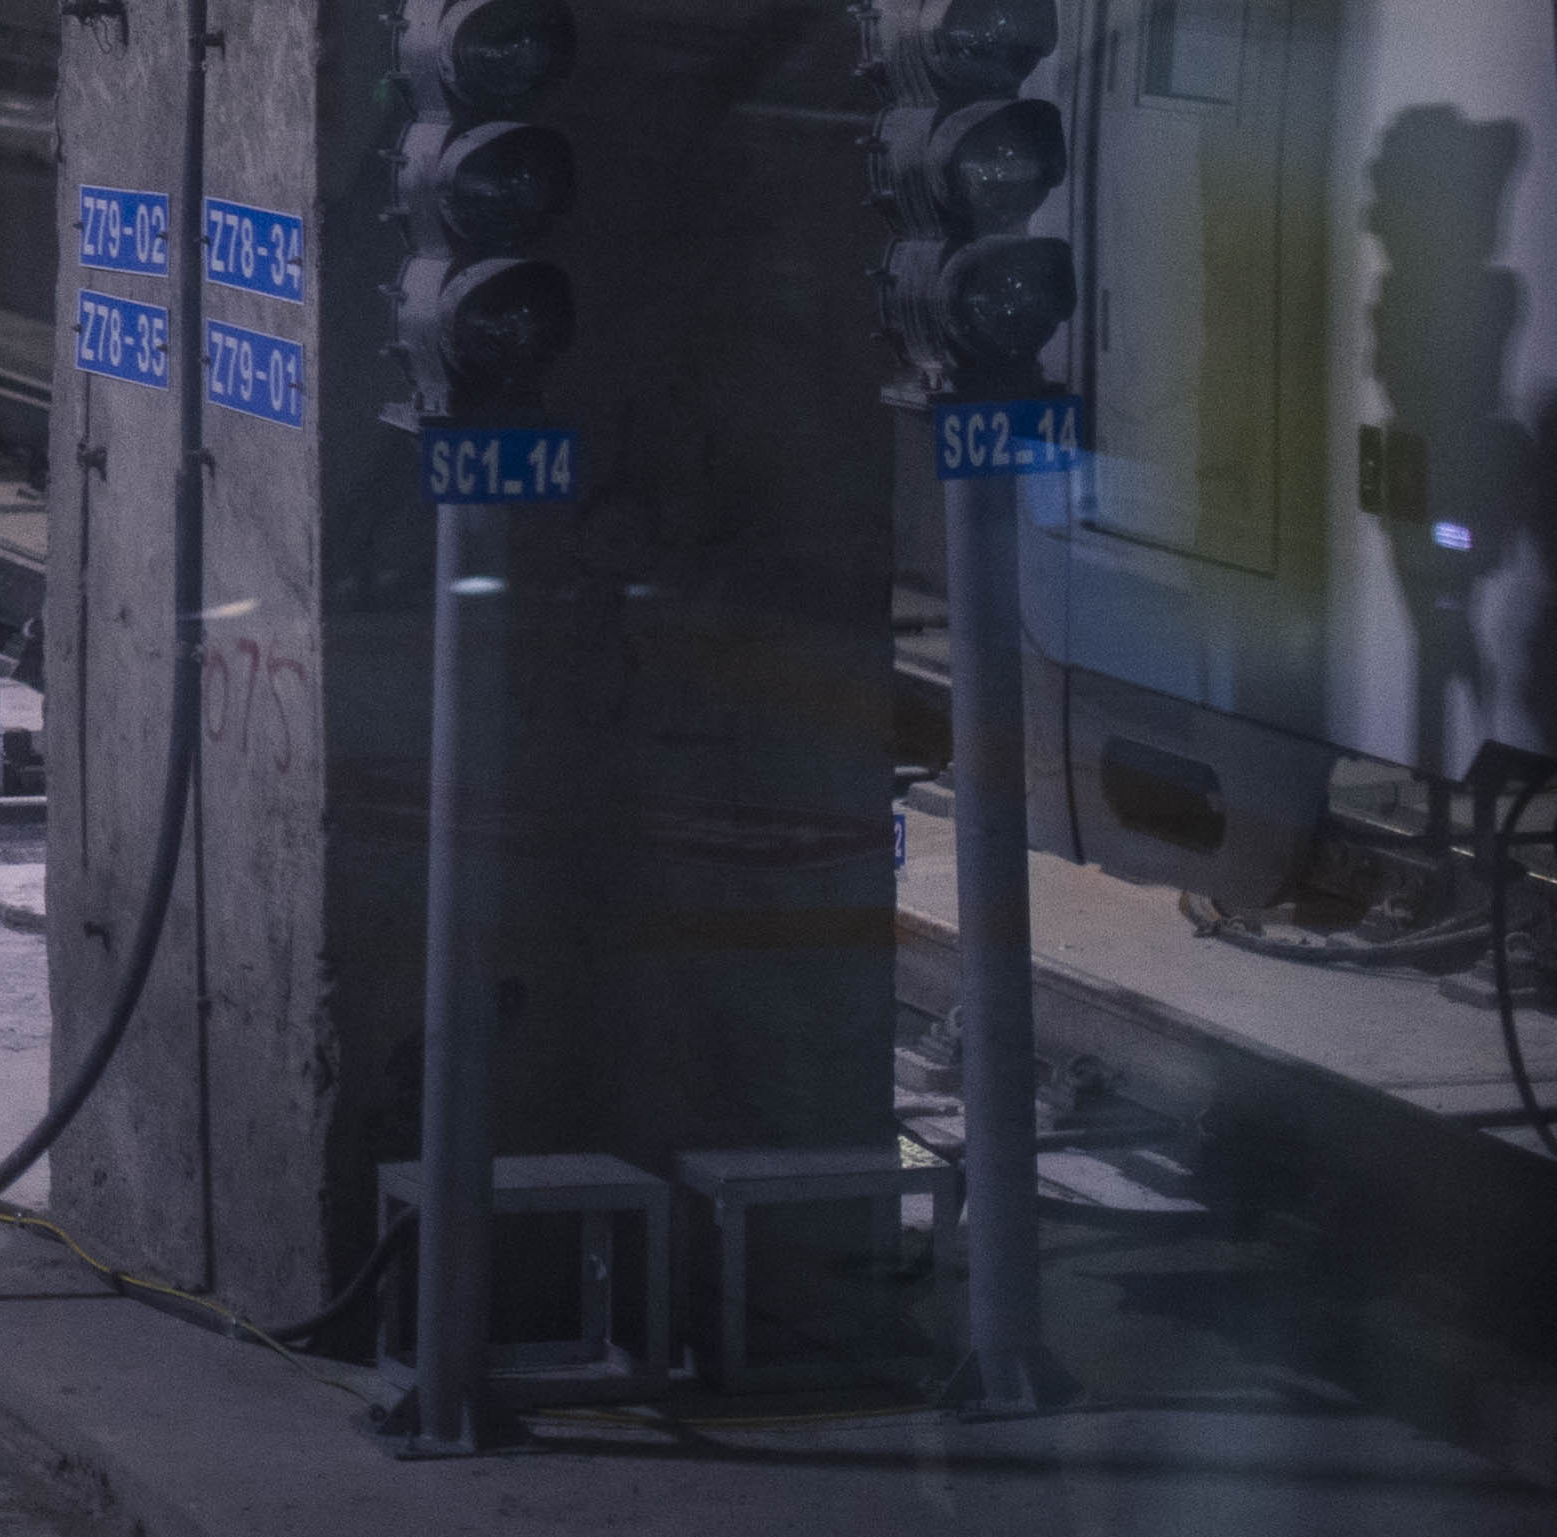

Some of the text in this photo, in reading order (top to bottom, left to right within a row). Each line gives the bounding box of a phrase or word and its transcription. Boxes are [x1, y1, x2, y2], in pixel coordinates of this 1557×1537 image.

[81, 196, 167, 265] Z79-02
[209, 210, 302, 290] Z78-34
[80, 300, 166, 377] Z78-35
[210, 332, 298, 416] Z79-01
